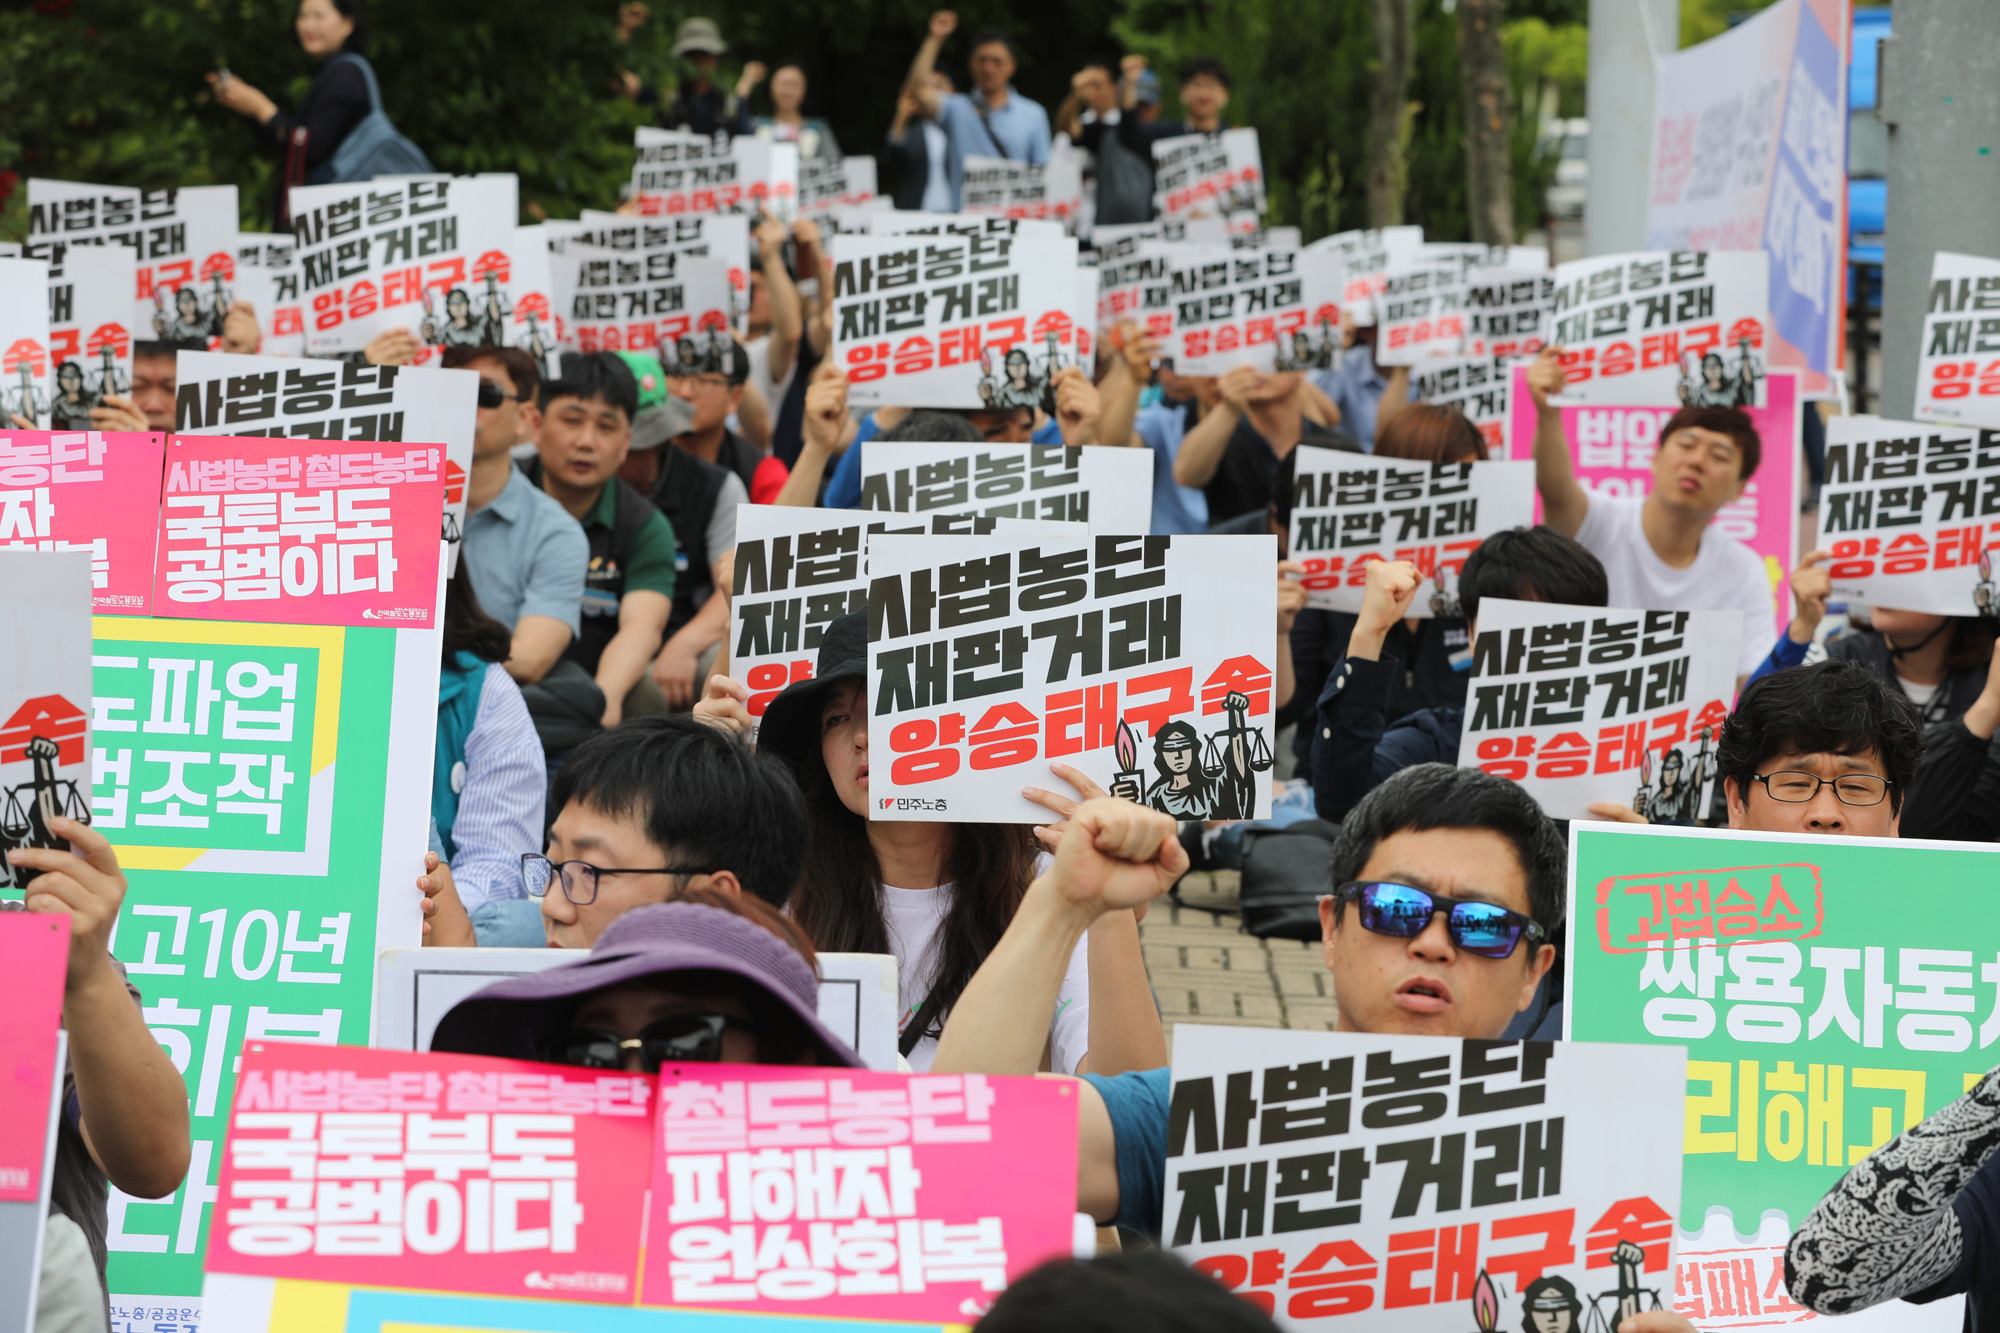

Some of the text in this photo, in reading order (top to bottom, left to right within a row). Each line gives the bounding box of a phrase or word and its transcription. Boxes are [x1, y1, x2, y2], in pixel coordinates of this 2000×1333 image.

[30, 189, 178, 235] 사법농단
[295, 181, 450, 248] 사법농단
[303, 215, 458, 292] 재판거래
[835, 238, 1011, 299] 사법농단
[1172, 253, 1295, 295] 사법농단
[1554, 251, 1709, 312] 사법농단
[313, 249, 511, 332] 양승태구속
[839, 274, 1019, 343] 재판거래
[1177, 279, 1303, 328] 재판거래
[1556, 284, 1715, 346] 재판거래
[846, 310, 1073, 384] 양승태구속
[177, 362, 399, 430] 사법농단
[167, 456, 302, 493] 사법농단
[306, 448, 440, 488] 철도농단
[862, 445, 1082, 513] 사법농단
[1296, 461, 1473, 508] 사법농단
[166, 487, 394, 548] 국토부도
[1295, 498, 1478, 551] 재판거래
[166, 541, 398, 603] 공범이다
[868, 535, 1170, 643] 사법농단
[875, 594, 1182, 716] 재판거래
[1470, 611, 1689, 678] 사법농단
[889, 654, 1272, 786] 양승태구속
[1469, 656, 1691, 733] 재판거래
[896, 797, 948, 811] 민주노총
[1624, 873, 1804, 944] 고법승소
[236, 1069, 651, 1117] 사법농단 철도농단
[662, 1074, 996, 1153] 철도농단
[1166, 1038, 1554, 1158] 사법농단
[231, 1112, 578, 1181] 국토부도
[666, 1146, 922, 1224] 피해자
[1171, 1116, 1565, 1247] 재판거래
[227, 1177, 584, 1257] 공범이다
[668, 1216, 1008, 1302] 원상회복
[1192, 1196, 1673, 1320] 양승태구속
